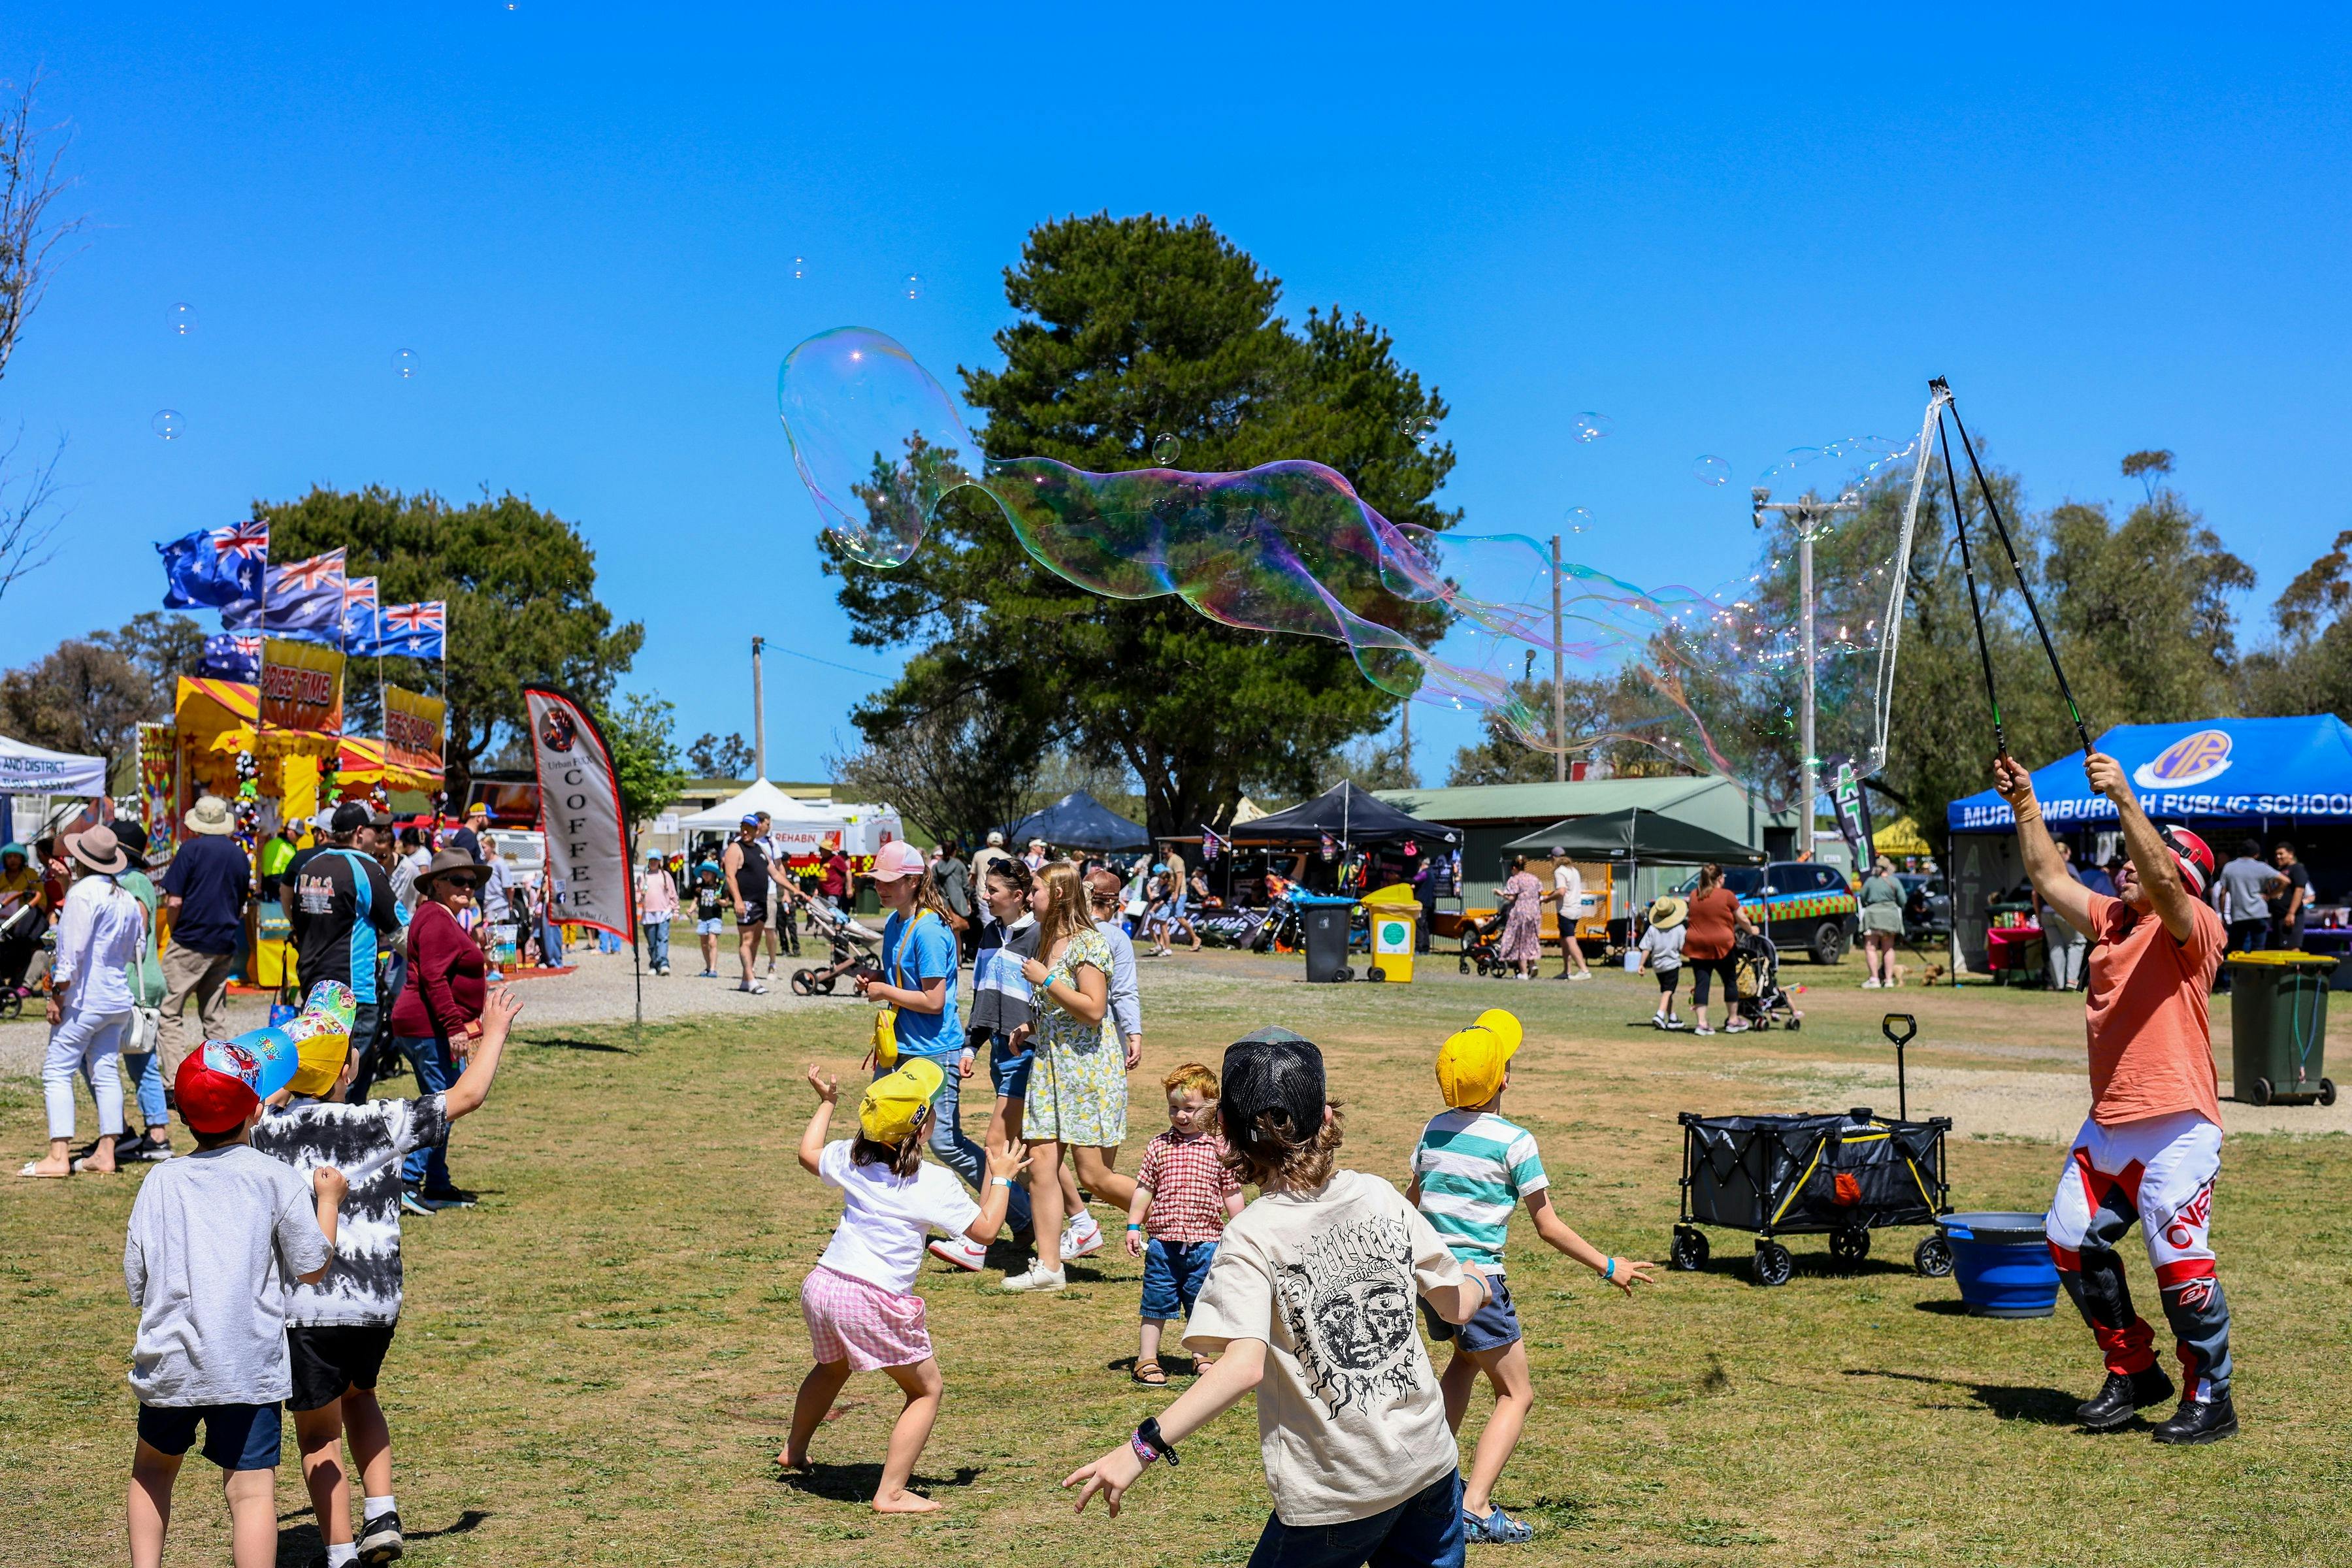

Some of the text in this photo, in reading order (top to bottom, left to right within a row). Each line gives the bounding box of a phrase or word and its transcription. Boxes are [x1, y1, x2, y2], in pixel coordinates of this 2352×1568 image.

[263, 662, 332, 707] PRIZE TIME
[3, 757, 65, 774] AND DISTRICT
[547, 760, 572, 770] Urban
[2162, 794, 2251, 814] PUBLIC
[2256, 793, 2352, 815] SCHOO
[564, 769, 594, 907] COFFEE
[259, 1035, 284, 1061] MARIO
